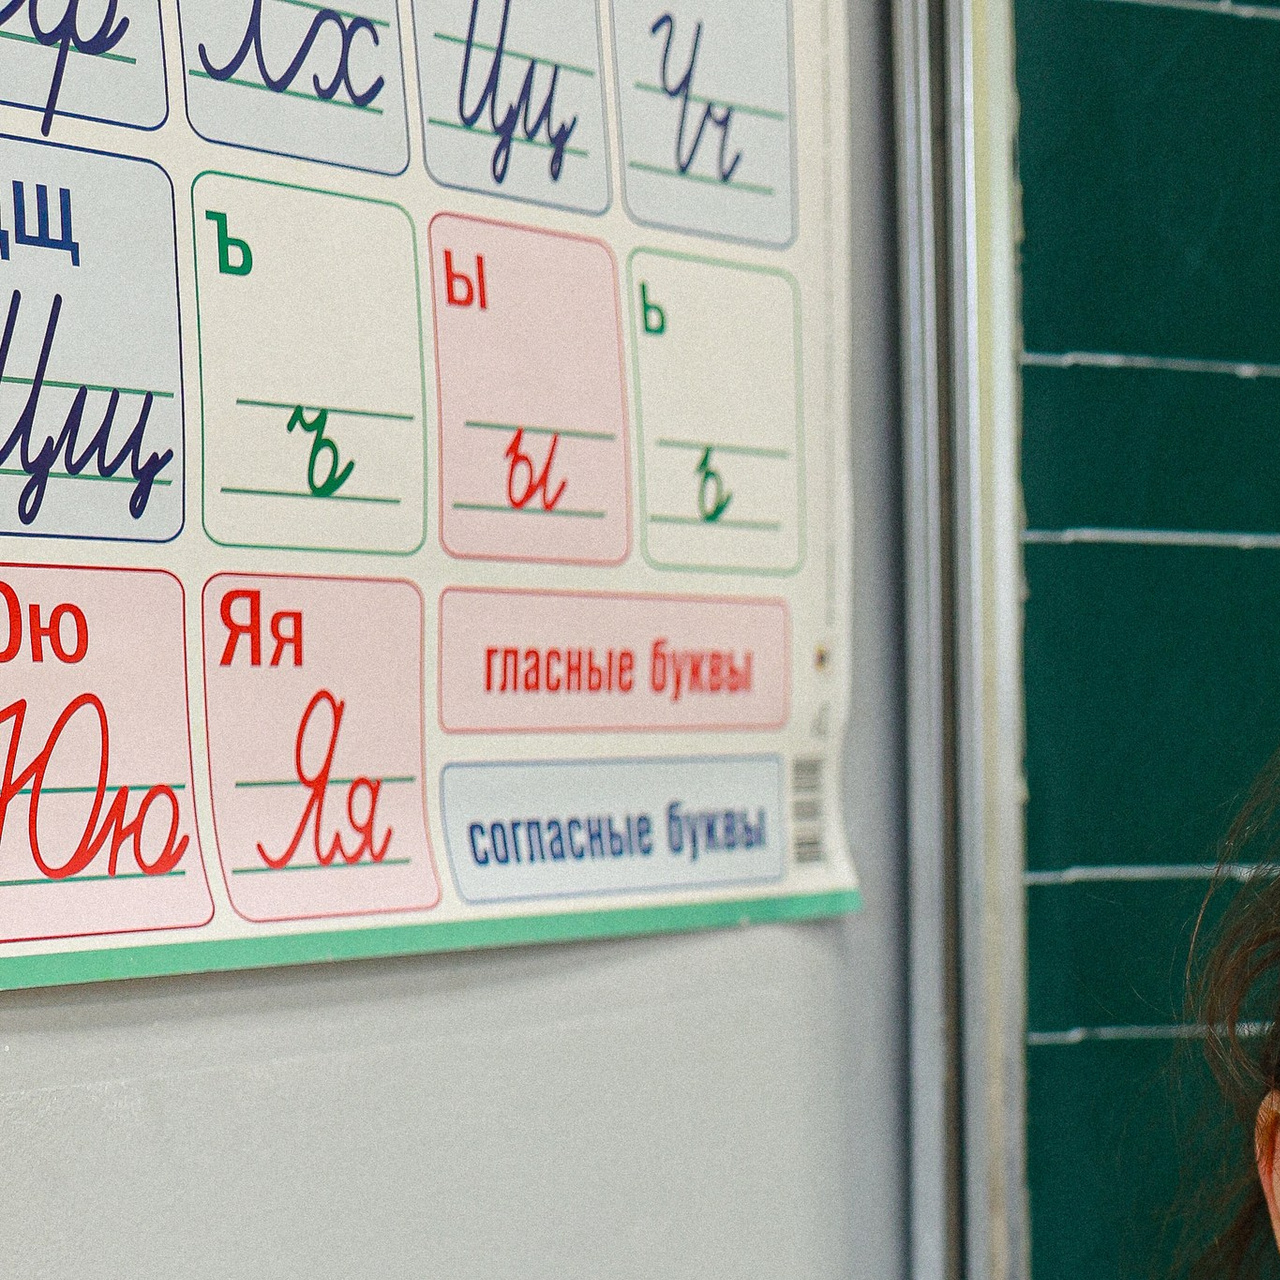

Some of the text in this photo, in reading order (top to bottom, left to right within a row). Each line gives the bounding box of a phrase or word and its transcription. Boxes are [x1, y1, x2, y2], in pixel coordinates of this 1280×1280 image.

[220, 590, 303, 667] Яя
[485, 637, 753, 703] гласные буквы
[257, 688, 392, 870] Яя
[469, 800, 767, 866] согласные буквы
